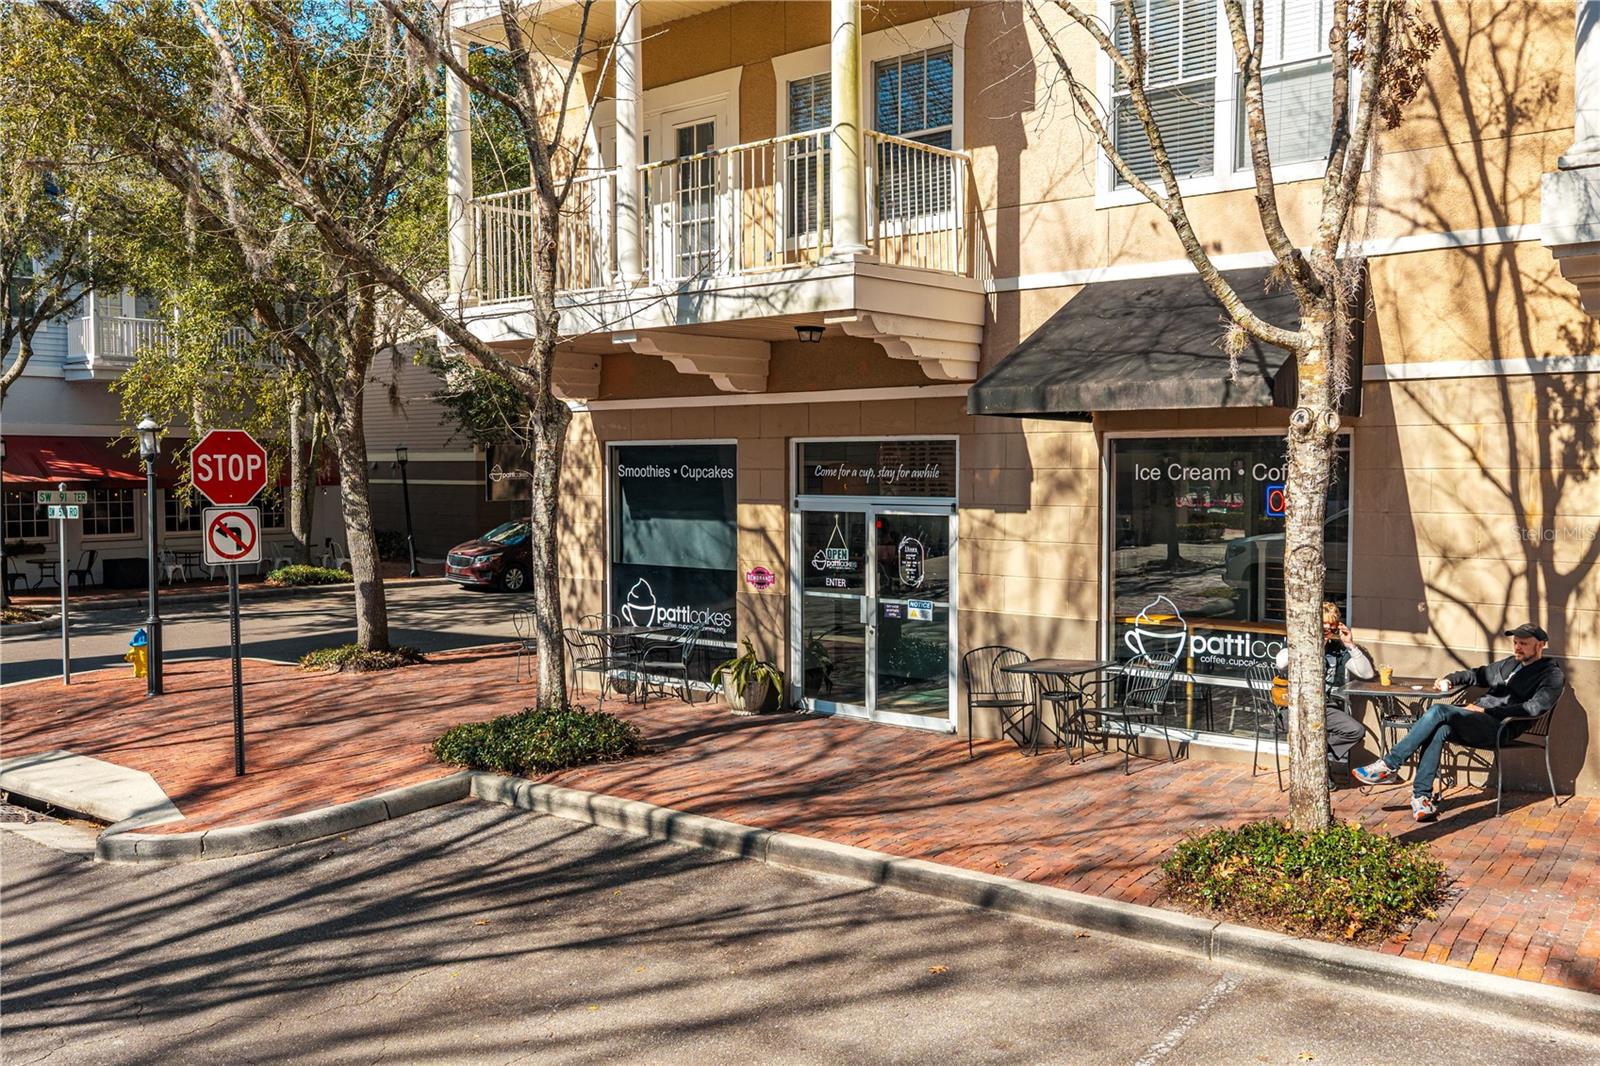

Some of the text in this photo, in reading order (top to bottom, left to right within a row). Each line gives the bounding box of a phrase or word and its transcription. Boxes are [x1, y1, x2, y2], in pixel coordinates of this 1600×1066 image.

[197, 453, 262, 482] STOP
[618, 464, 734, 481] Smoothies Cupcakes
[814, 463, 940, 484] Come for a cup, stay for awhile
[1134, 463, 1289, 481] Ice Cream Cof
[39, 492, 86, 502] SW 91 TER
[826, 549, 848, 560] OPEN
[825, 577, 847, 588] ENTER
[909, 601, 931, 609] NOTICE
[656, 605, 732, 627] patticakes
[1190, 633, 1287, 660] pattica
